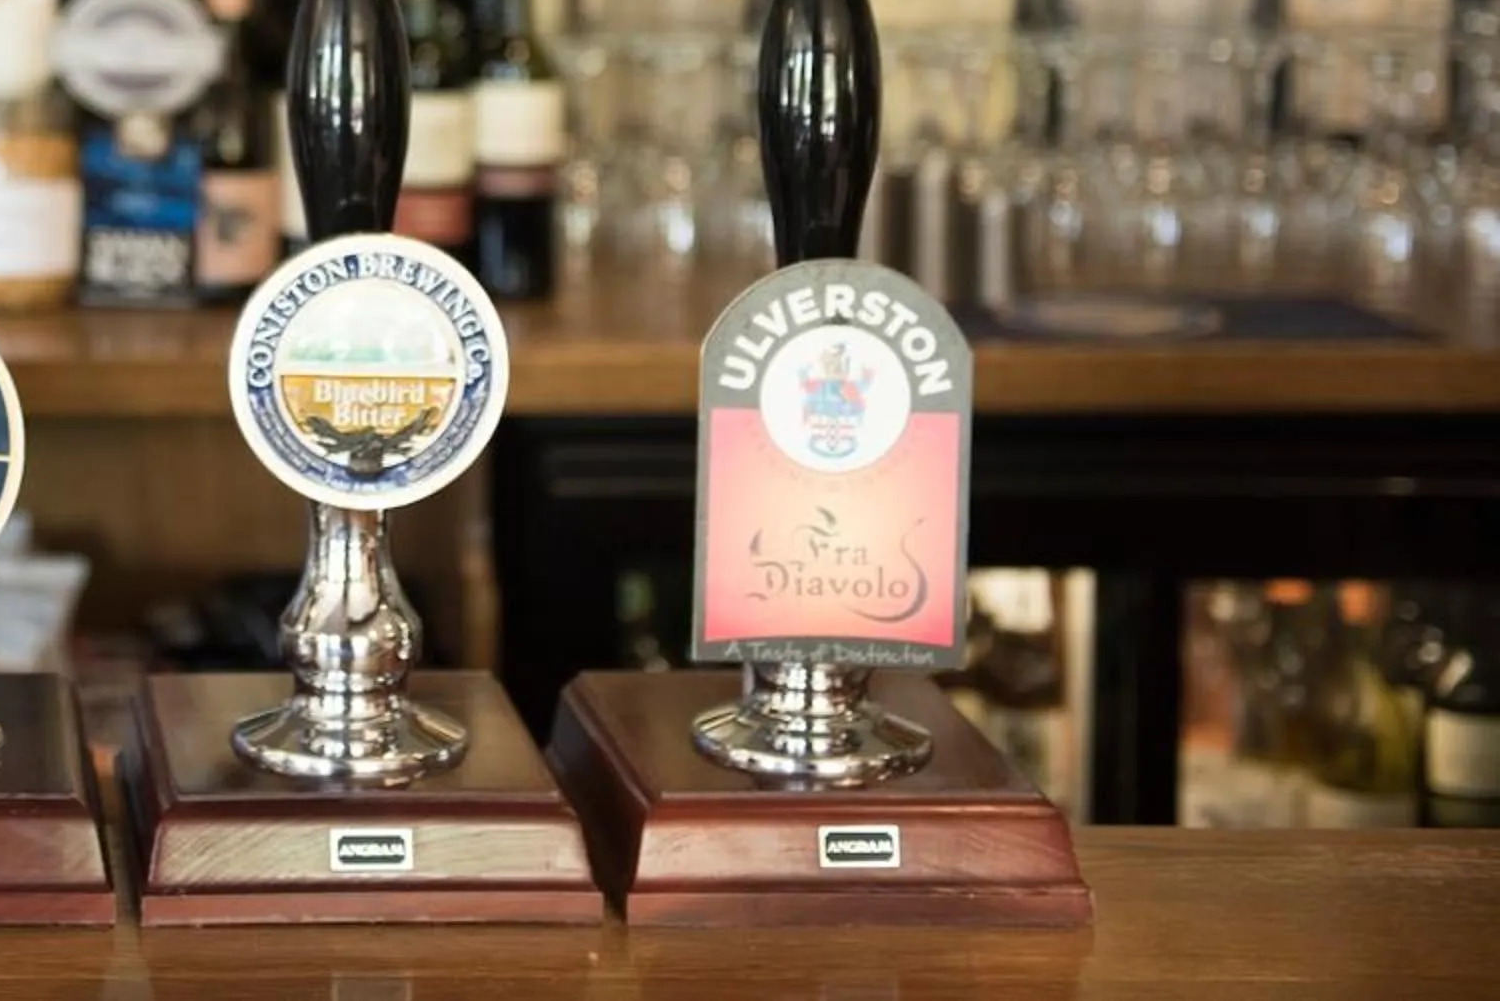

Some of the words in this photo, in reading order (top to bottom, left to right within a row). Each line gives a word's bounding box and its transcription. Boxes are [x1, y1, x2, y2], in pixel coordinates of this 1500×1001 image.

[250, 256, 348, 387] CONISTON
[357, 253, 482, 338] BREWING
[718, 283, 953, 397] ULVERSTON
[795, 511, 869, 567] Fra
[747, 560, 911, 601] Diavolo
[724, 641, 744, 660] A
